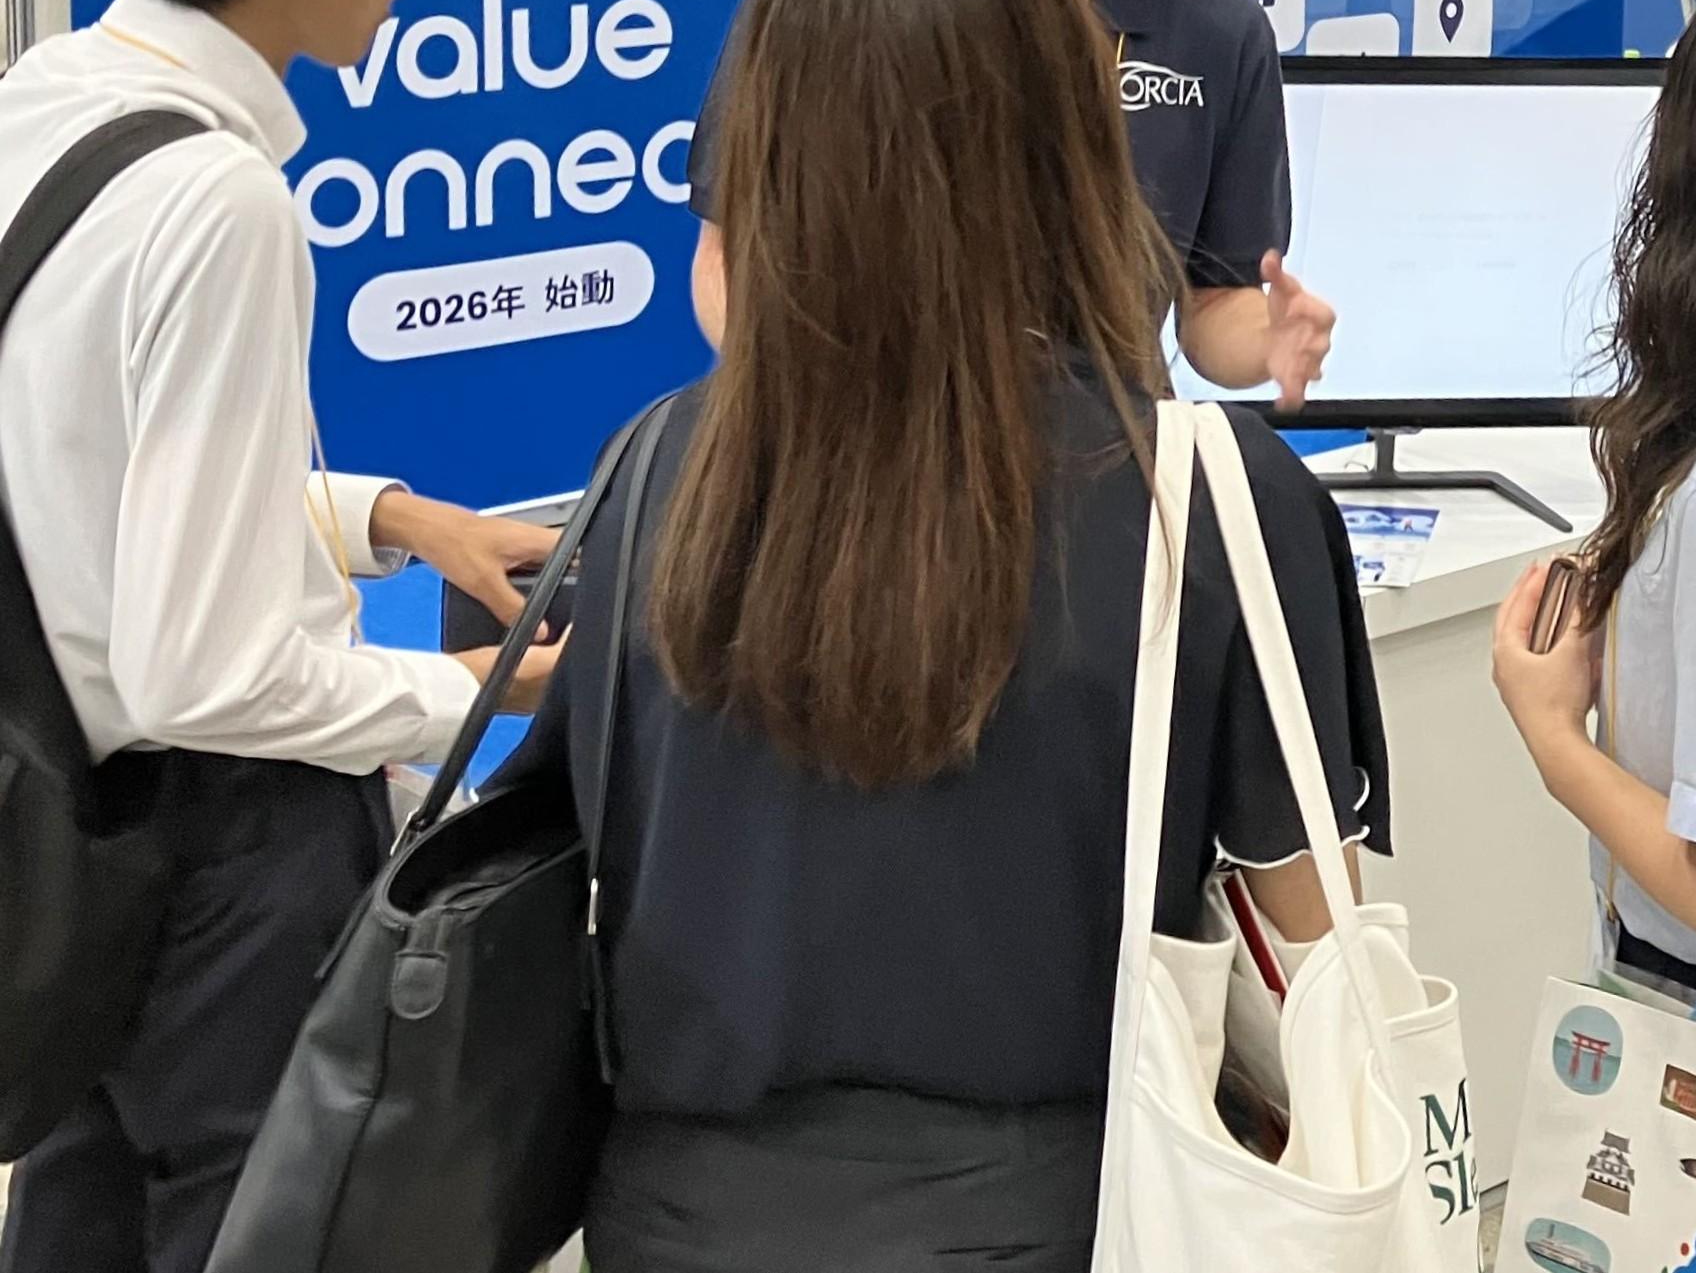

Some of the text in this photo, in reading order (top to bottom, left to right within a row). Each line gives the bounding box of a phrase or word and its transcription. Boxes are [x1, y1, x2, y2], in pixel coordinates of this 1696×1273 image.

[1120, 70, 1204, 108] ORCIA
[294, 119, 693, 248] onnec
[395, 269, 616, 334] 2026年 始動
